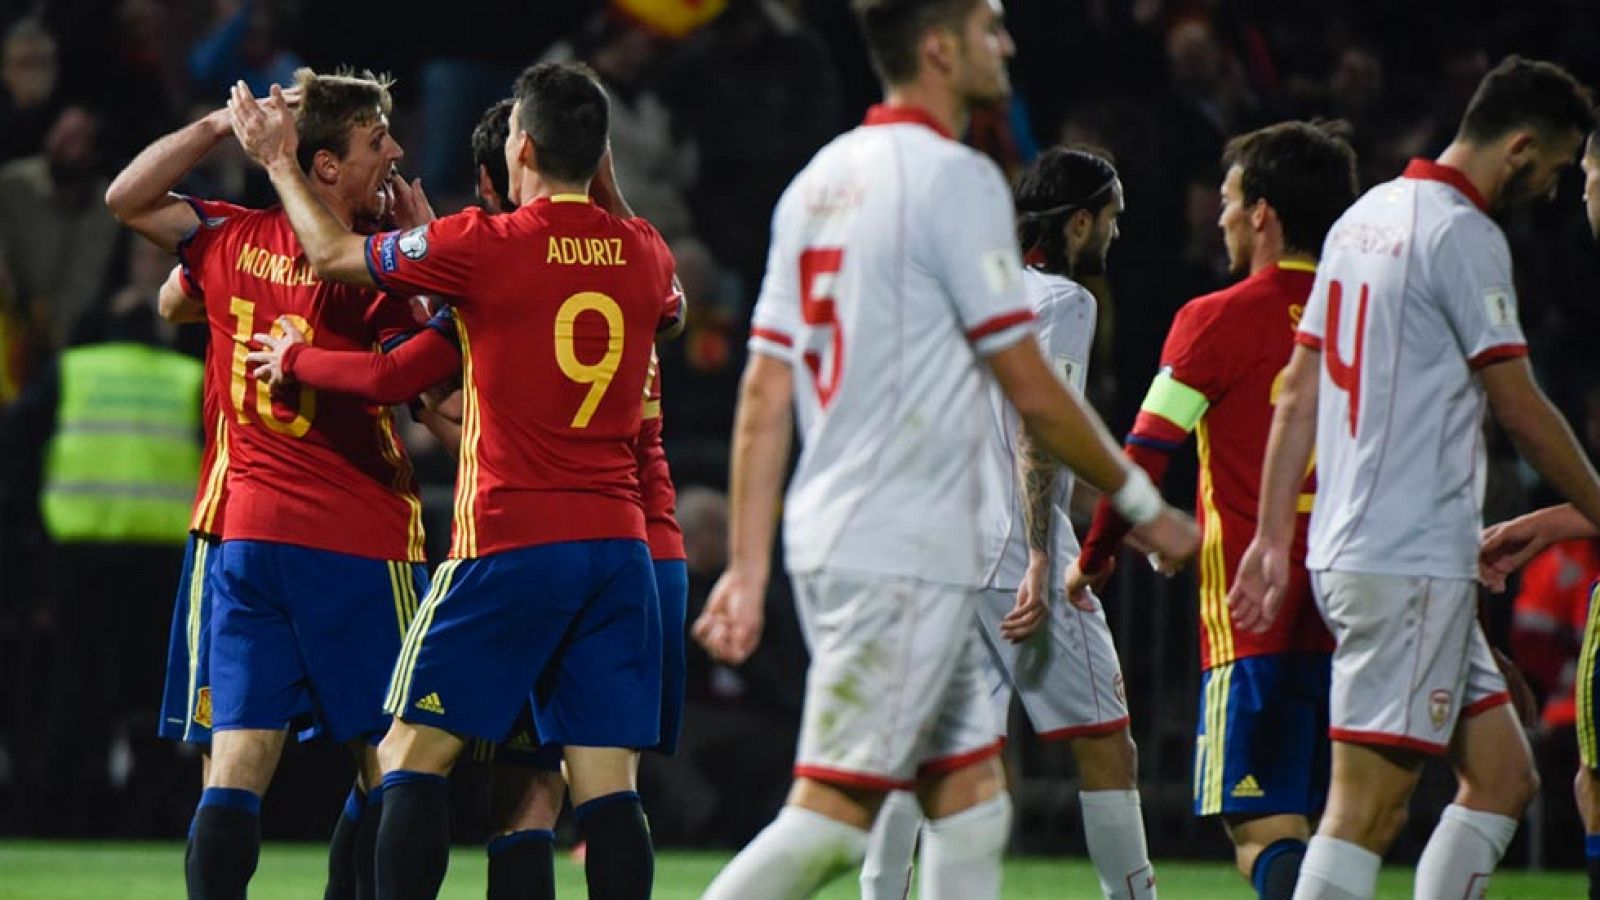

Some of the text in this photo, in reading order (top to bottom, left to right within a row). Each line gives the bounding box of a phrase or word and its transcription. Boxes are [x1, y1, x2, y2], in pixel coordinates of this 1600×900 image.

[546, 236, 627, 265] ADURIZ
[554, 292, 625, 428] 9
[798, 247, 843, 408] 5
[1325, 280, 1368, 438] 4
